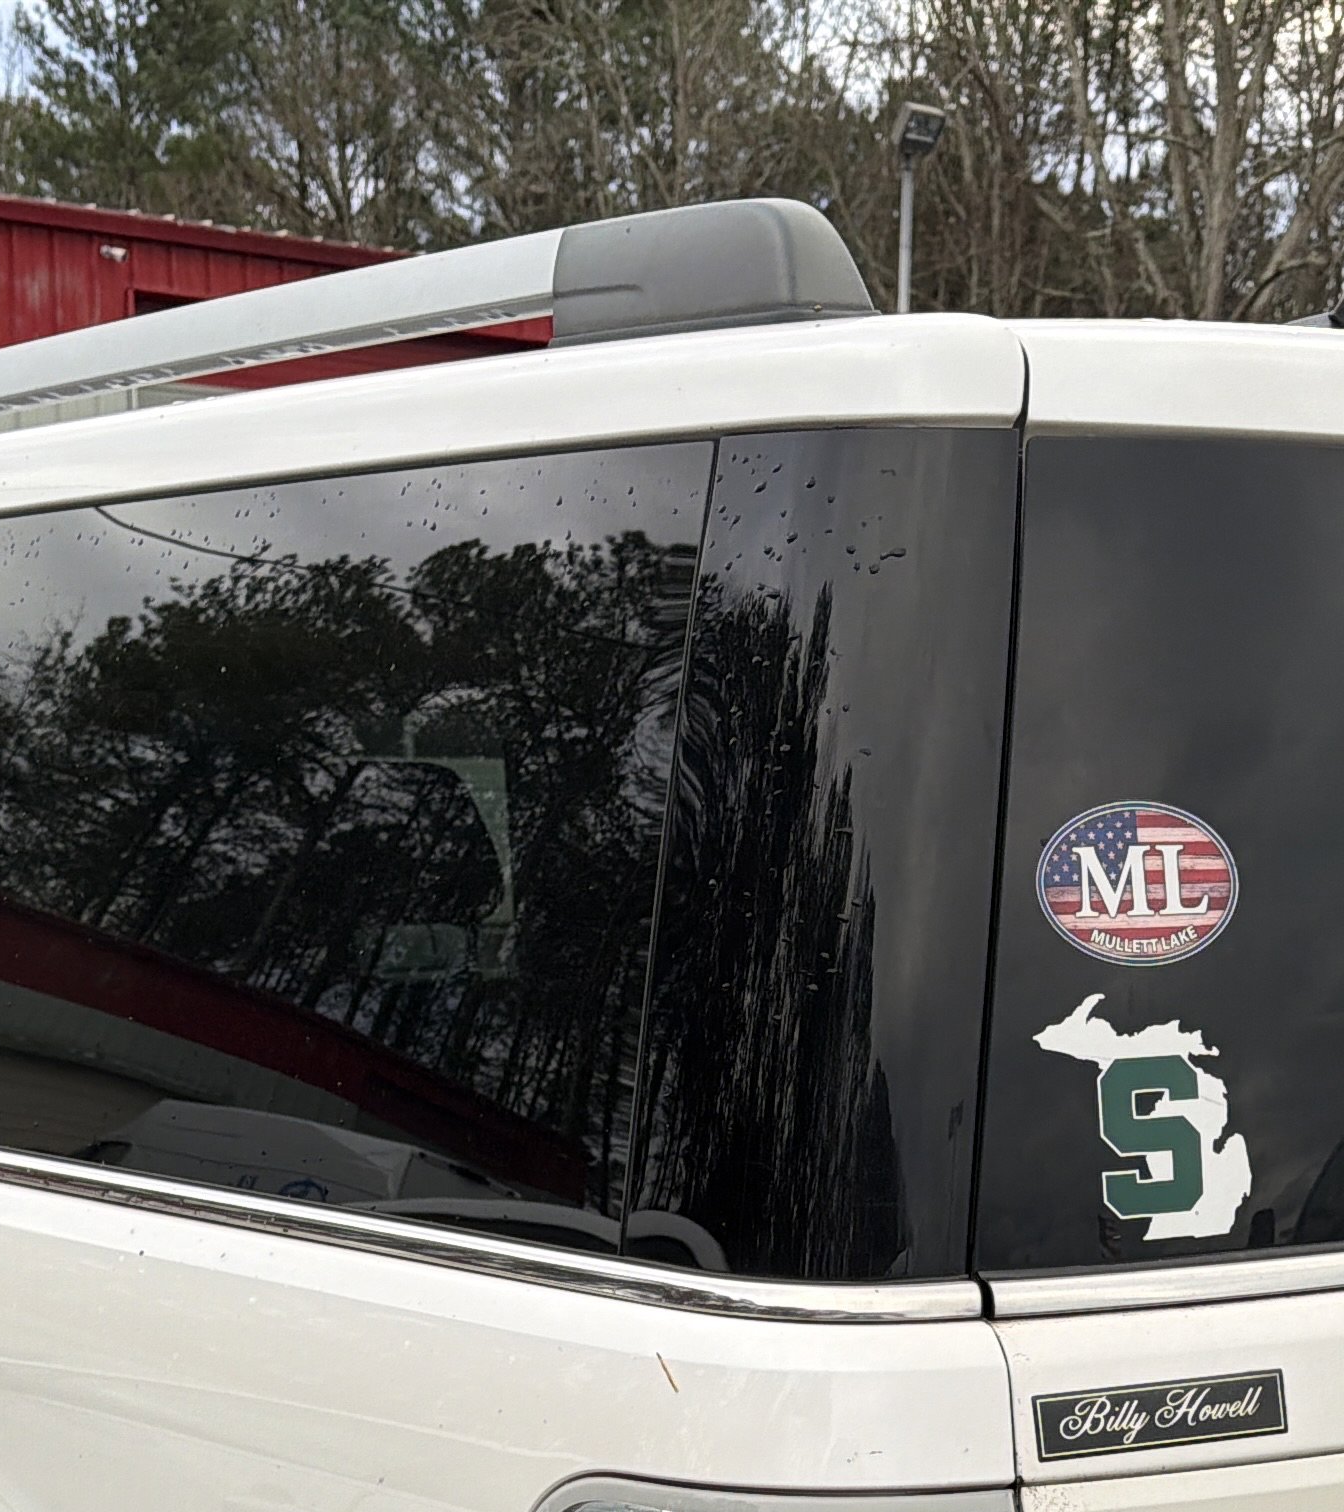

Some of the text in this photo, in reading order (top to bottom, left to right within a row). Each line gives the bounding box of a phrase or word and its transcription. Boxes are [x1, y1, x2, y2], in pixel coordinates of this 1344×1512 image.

[1072, 843, 1210, 918] ML
[1090, 925, 1199, 953] MULLETT LAKE
[1097, 1054, 1204, 1219] S
[1059, 1386, 1263, 1444] Billy Howell
